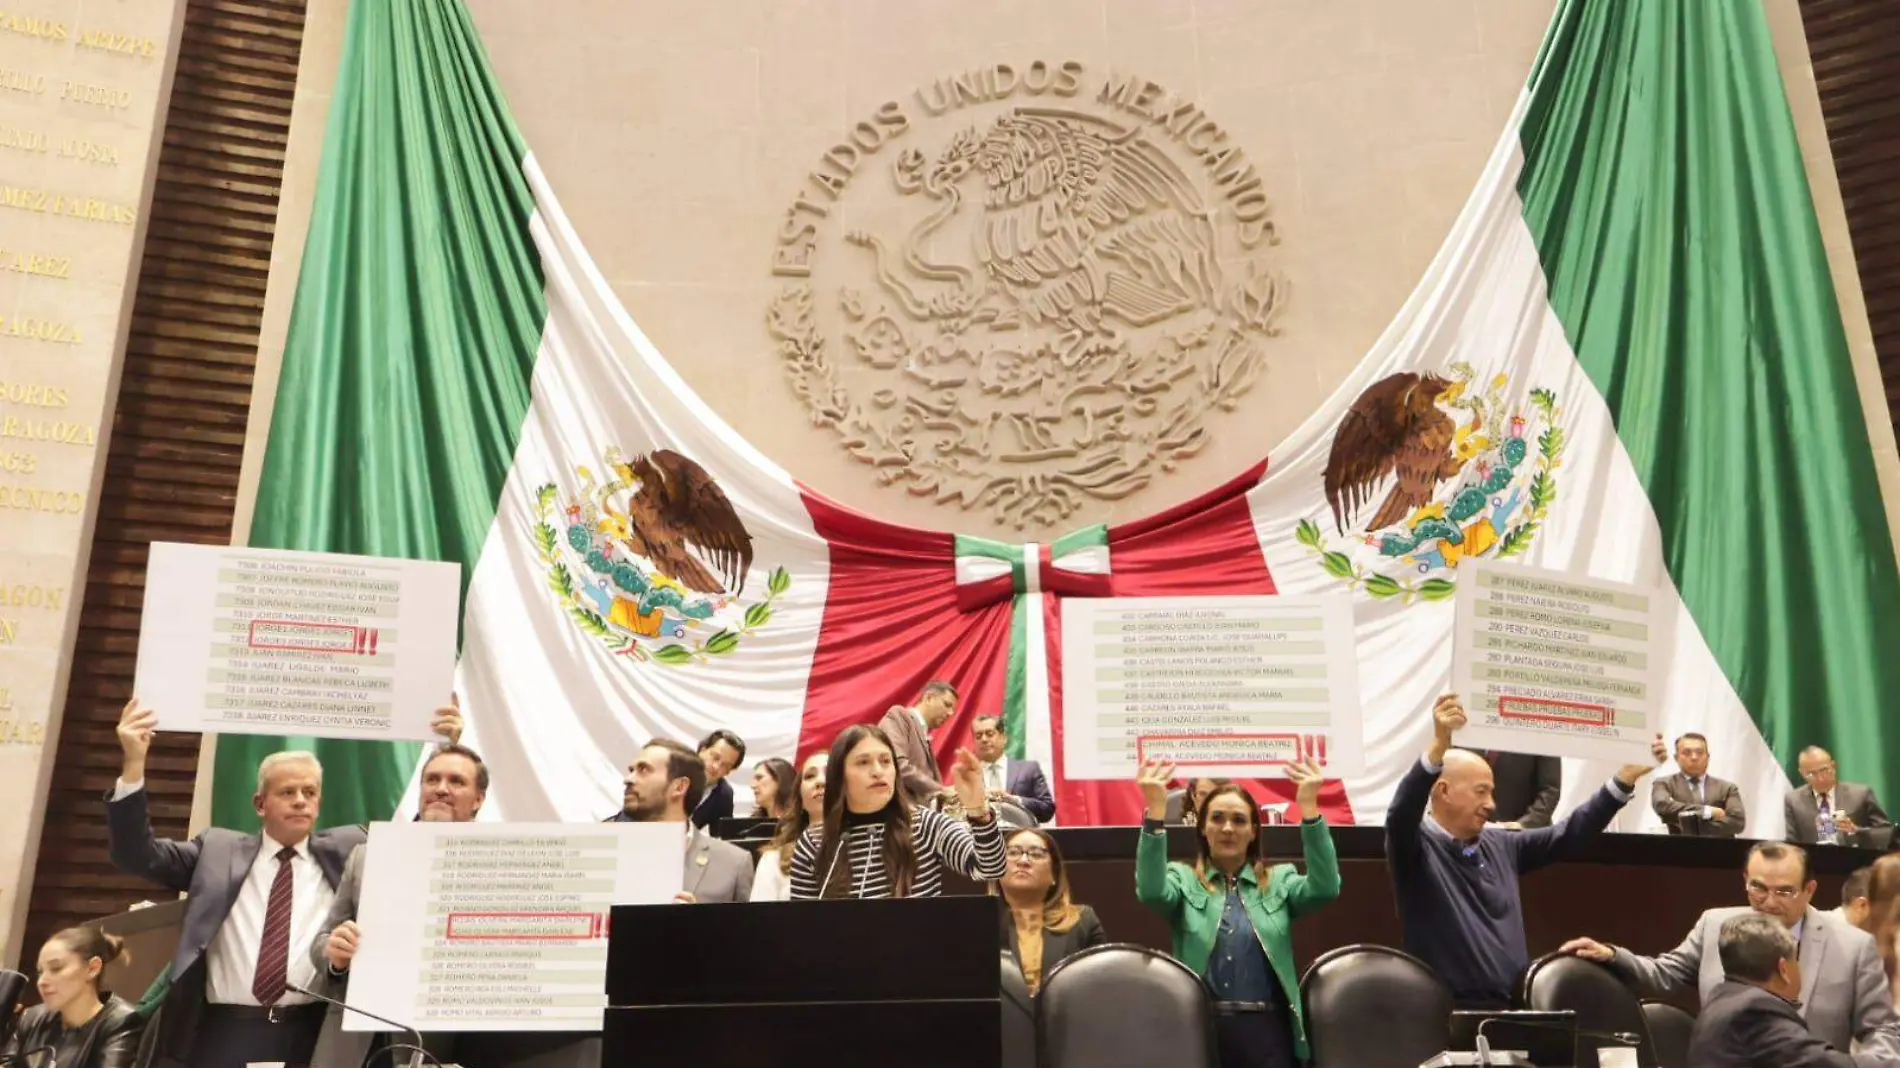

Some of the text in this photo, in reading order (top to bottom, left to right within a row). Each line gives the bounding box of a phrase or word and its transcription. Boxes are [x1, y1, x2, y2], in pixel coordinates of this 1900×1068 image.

[53, 195, 138, 225] FARIAS
[771, 59, 1282, 278] ESTADOS UNIDOS MEXICANOS
